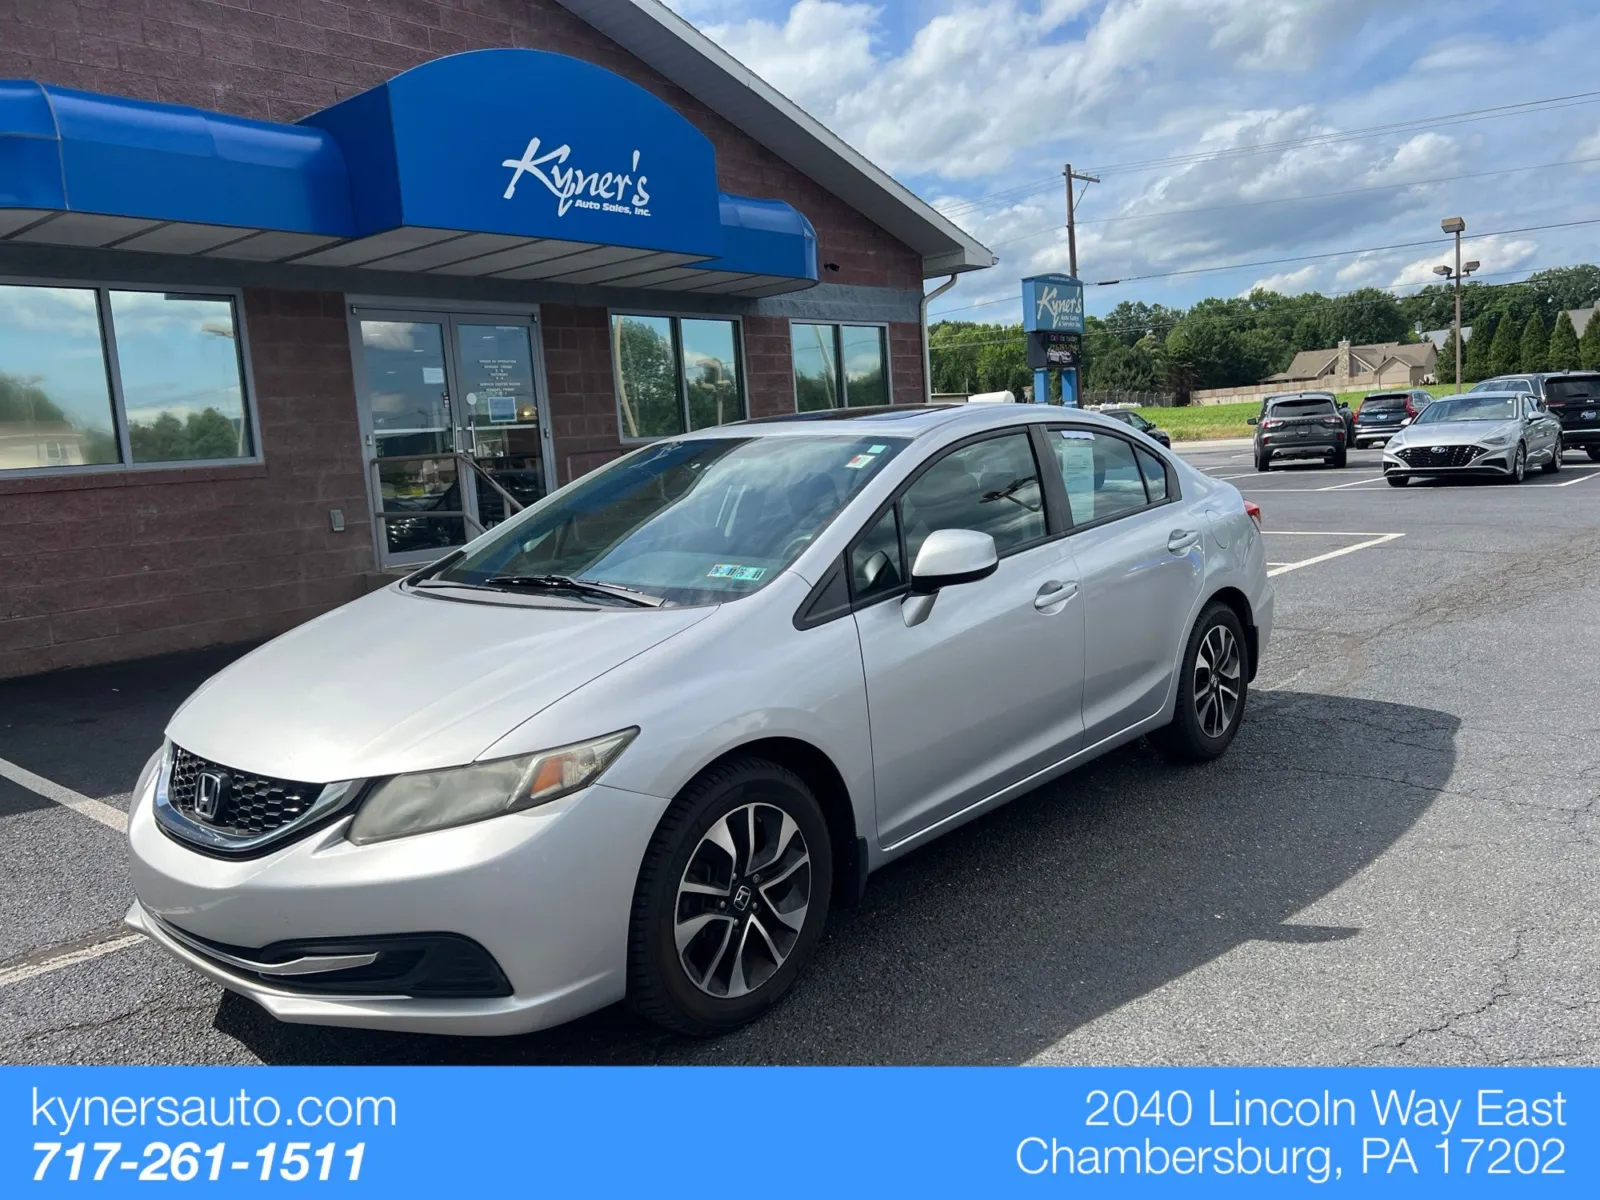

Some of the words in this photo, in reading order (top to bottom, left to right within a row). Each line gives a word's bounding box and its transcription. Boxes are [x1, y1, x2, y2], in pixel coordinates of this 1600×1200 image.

[502, 137, 650, 216] Kyner's
[575, 200, 600, 210] Auto
[602, 202, 632, 215] Sales,
[634, 207, 652, 217] Inc.
[1037, 286, 1082, 329] Kyner's
